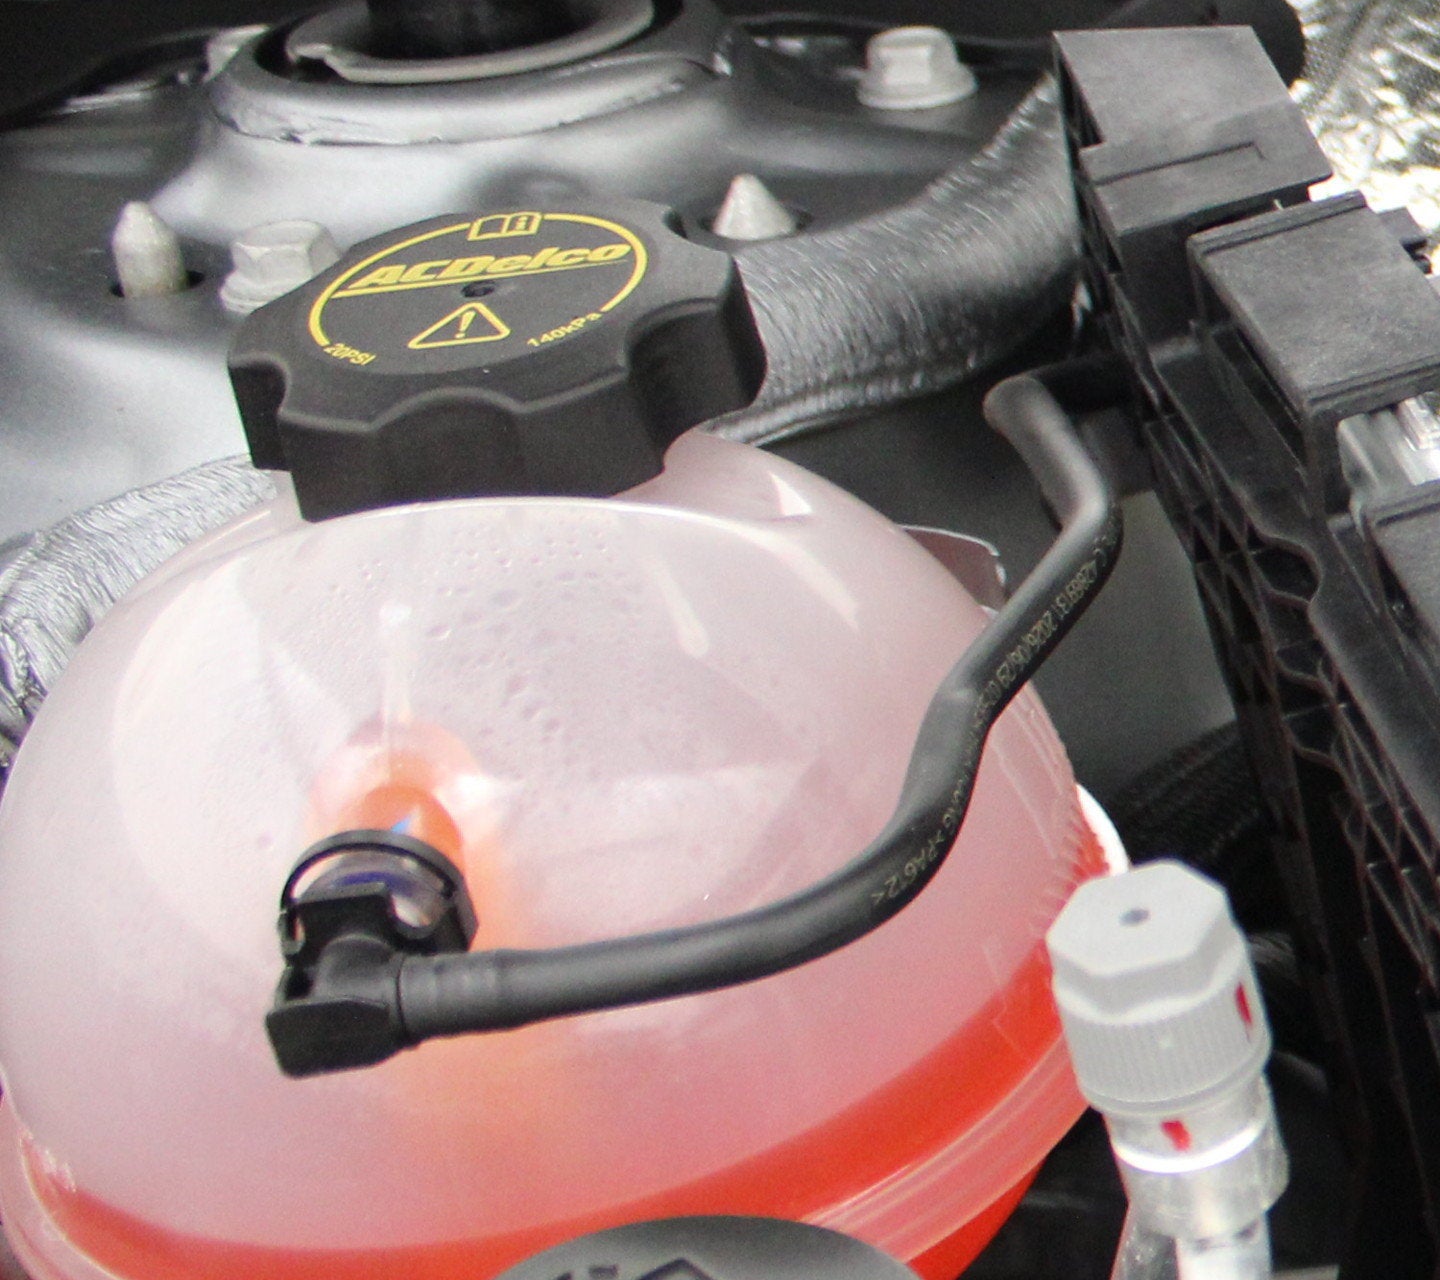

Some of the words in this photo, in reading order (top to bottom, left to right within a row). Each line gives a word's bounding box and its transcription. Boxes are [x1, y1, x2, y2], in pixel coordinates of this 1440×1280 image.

[348, 243, 632, 289] ACDelco
[527, 311, 603, 348] 140kPa
[324, 341, 377, 366] 20PSI
